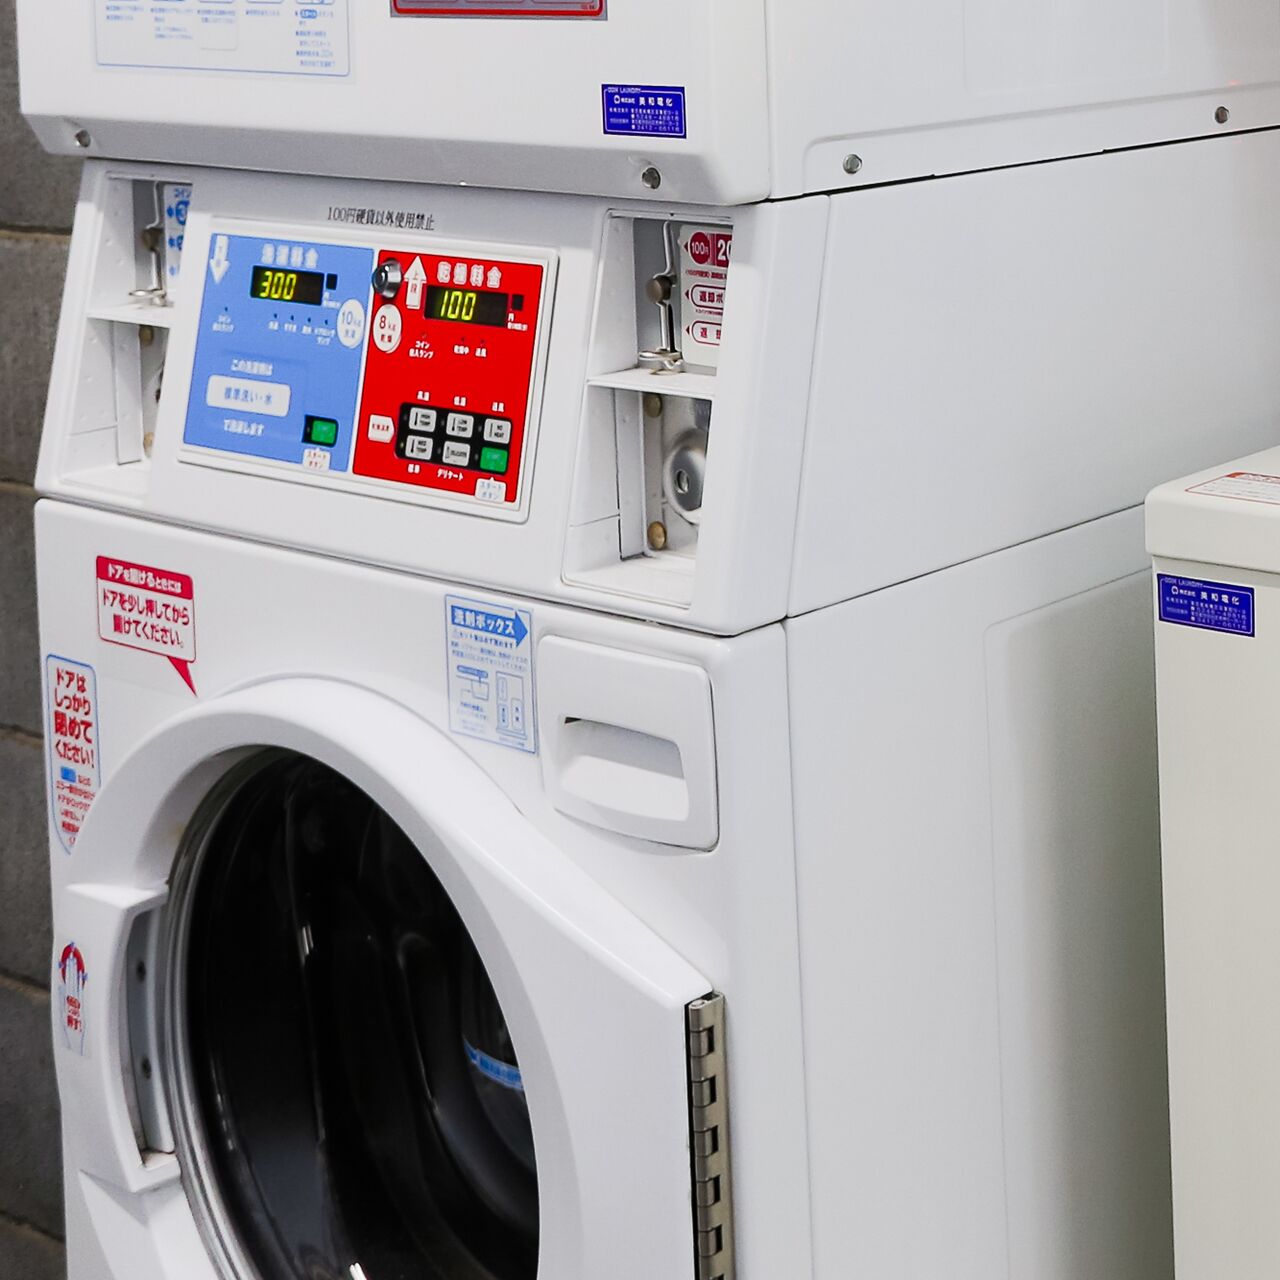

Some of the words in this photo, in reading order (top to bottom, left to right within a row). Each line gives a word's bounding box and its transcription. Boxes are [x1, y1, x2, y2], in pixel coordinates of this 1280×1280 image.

[327, 206, 434, 232] 100円硬貨以外使用禁止
[259, 271, 297, 301] 300
[441, 290, 477, 321] 100
[103, 588, 189, 626] ドアを少し押してから
[113, 613, 184, 649] 開けてください。
[454, 608, 515, 636] 洗剤ボックス
[56, 667, 86, 693] ドアは
[55, 688, 91, 716] しっかり
[54, 710, 93, 744] 閉めて
[55, 740, 95, 769] ください!
